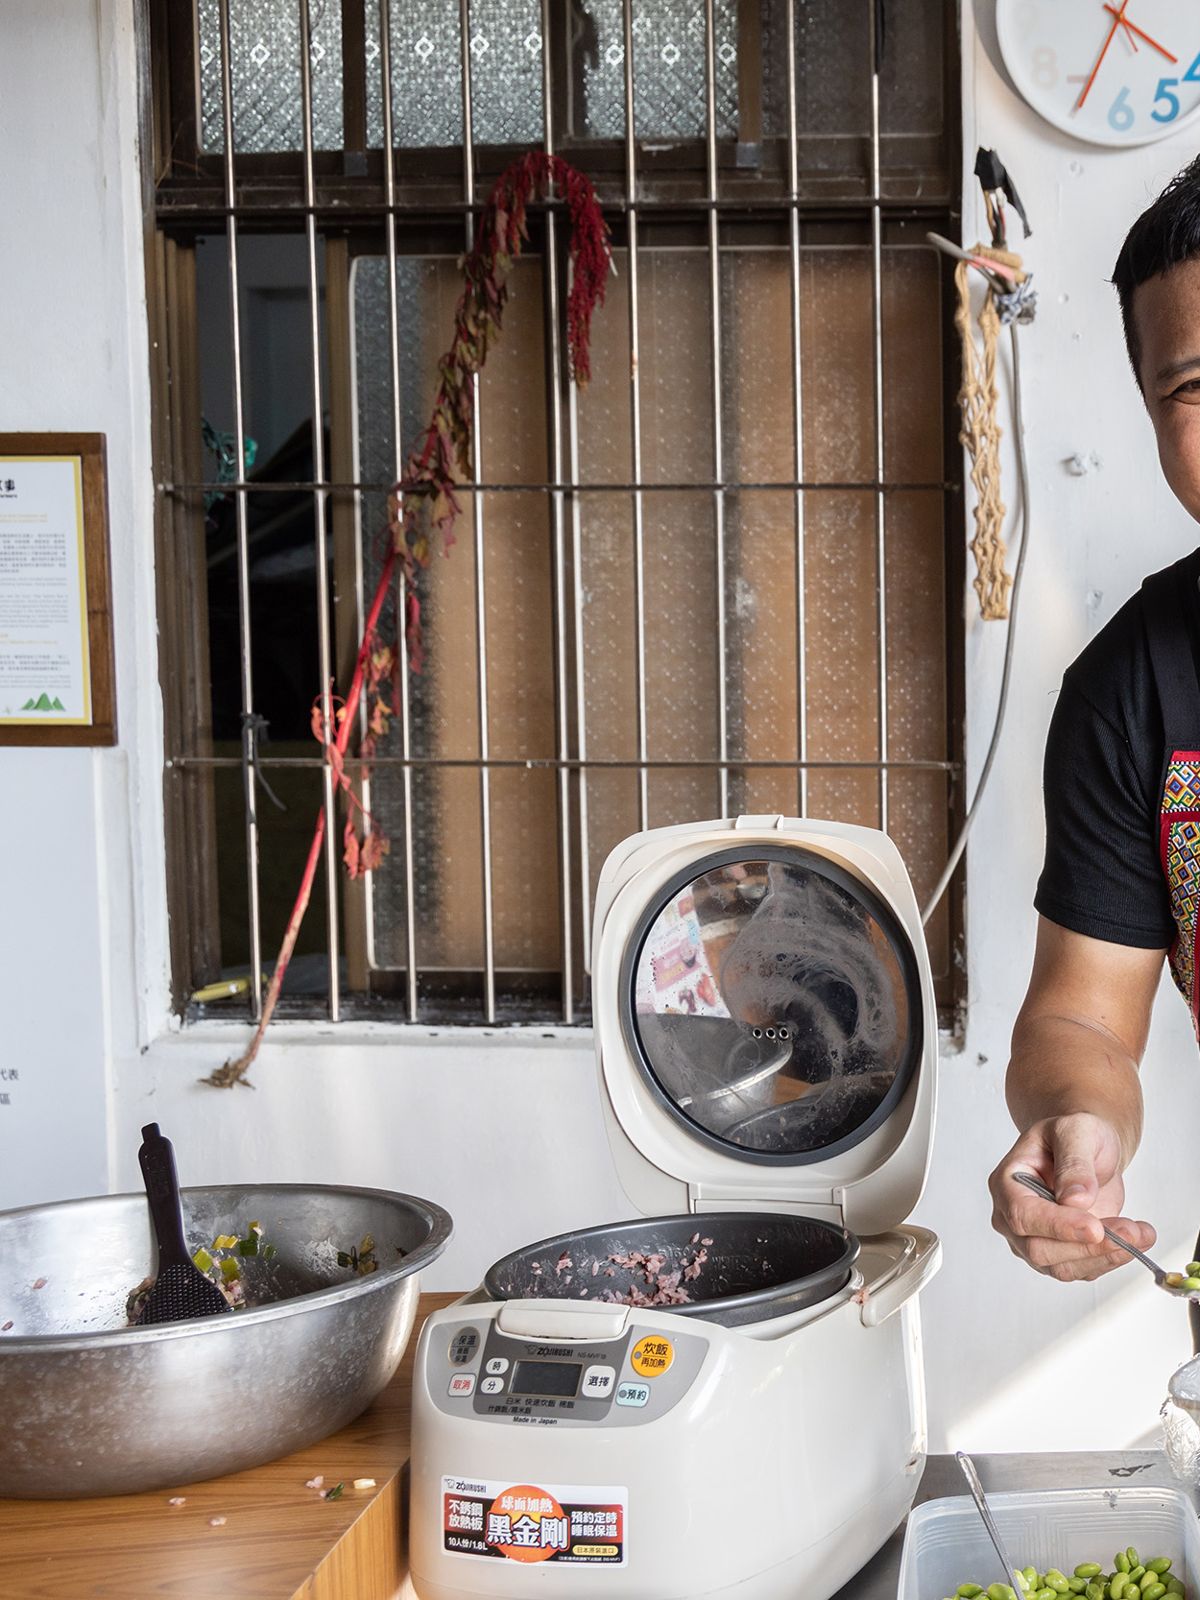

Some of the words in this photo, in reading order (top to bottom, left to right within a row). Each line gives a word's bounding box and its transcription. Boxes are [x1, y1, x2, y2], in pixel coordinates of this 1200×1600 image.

[1151, 78, 1180, 123] 5
[1107, 86, 1135, 132] 6
[643, 1343, 669, 1356] 炊飯
[641, 1357, 666, 1368] 再加熱
[453, 1379, 472, 1390] 取消
[487, 1381, 496, 1391] 分
[588, 1376, 610, 1387] 選擇
[627, 1389, 647, 1400] 預約
[571, 1511, 617, 1524] 預約定時
[487, 1513, 568, 1549] 黑金剛
[571, 1524, 617, 1537] 睡眠保溫
